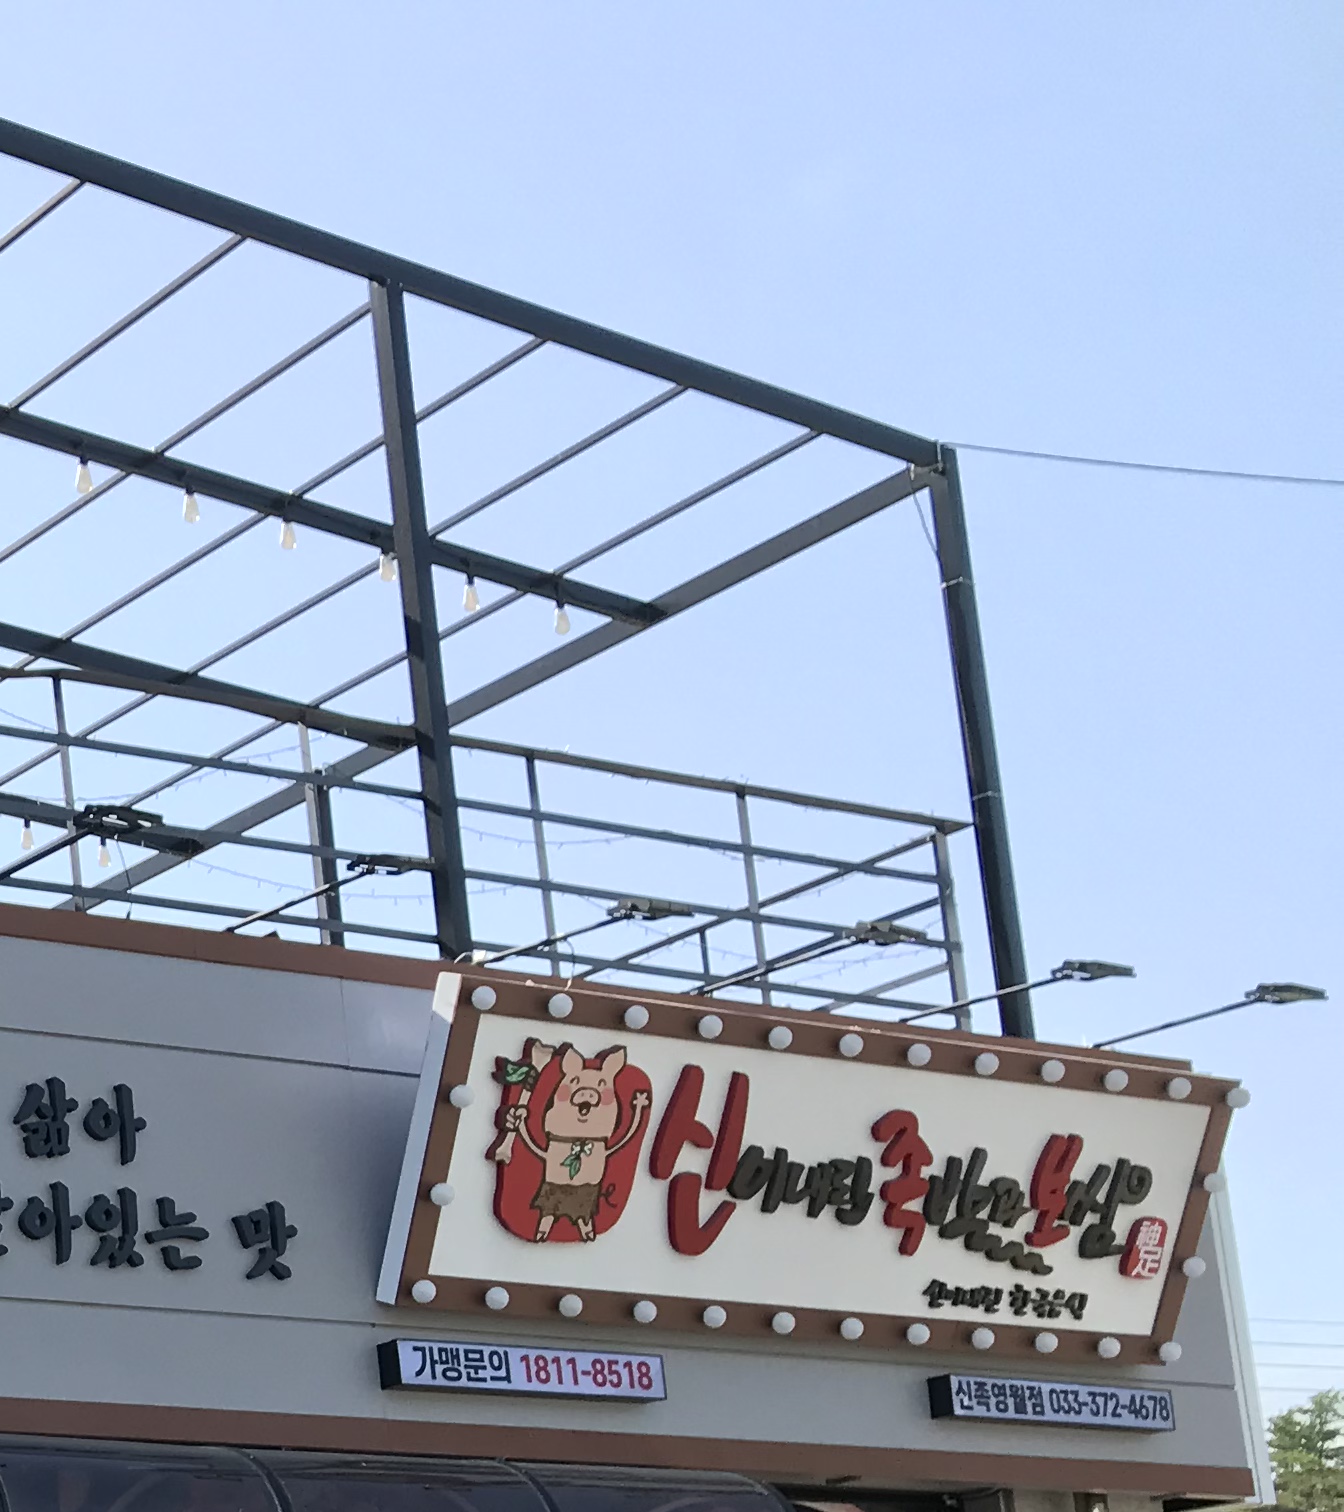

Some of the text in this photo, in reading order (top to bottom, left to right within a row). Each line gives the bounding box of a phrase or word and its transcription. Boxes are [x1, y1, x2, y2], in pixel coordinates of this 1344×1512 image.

[12, 1076, 147, 1166] 삶아
[230, 1200, 298, 1281] 맛
[412, 1345, 653, 1391] 가맹문의 1811-8518
[955, 1379, 1171, 1422] 신족영월점 033-372-4678
